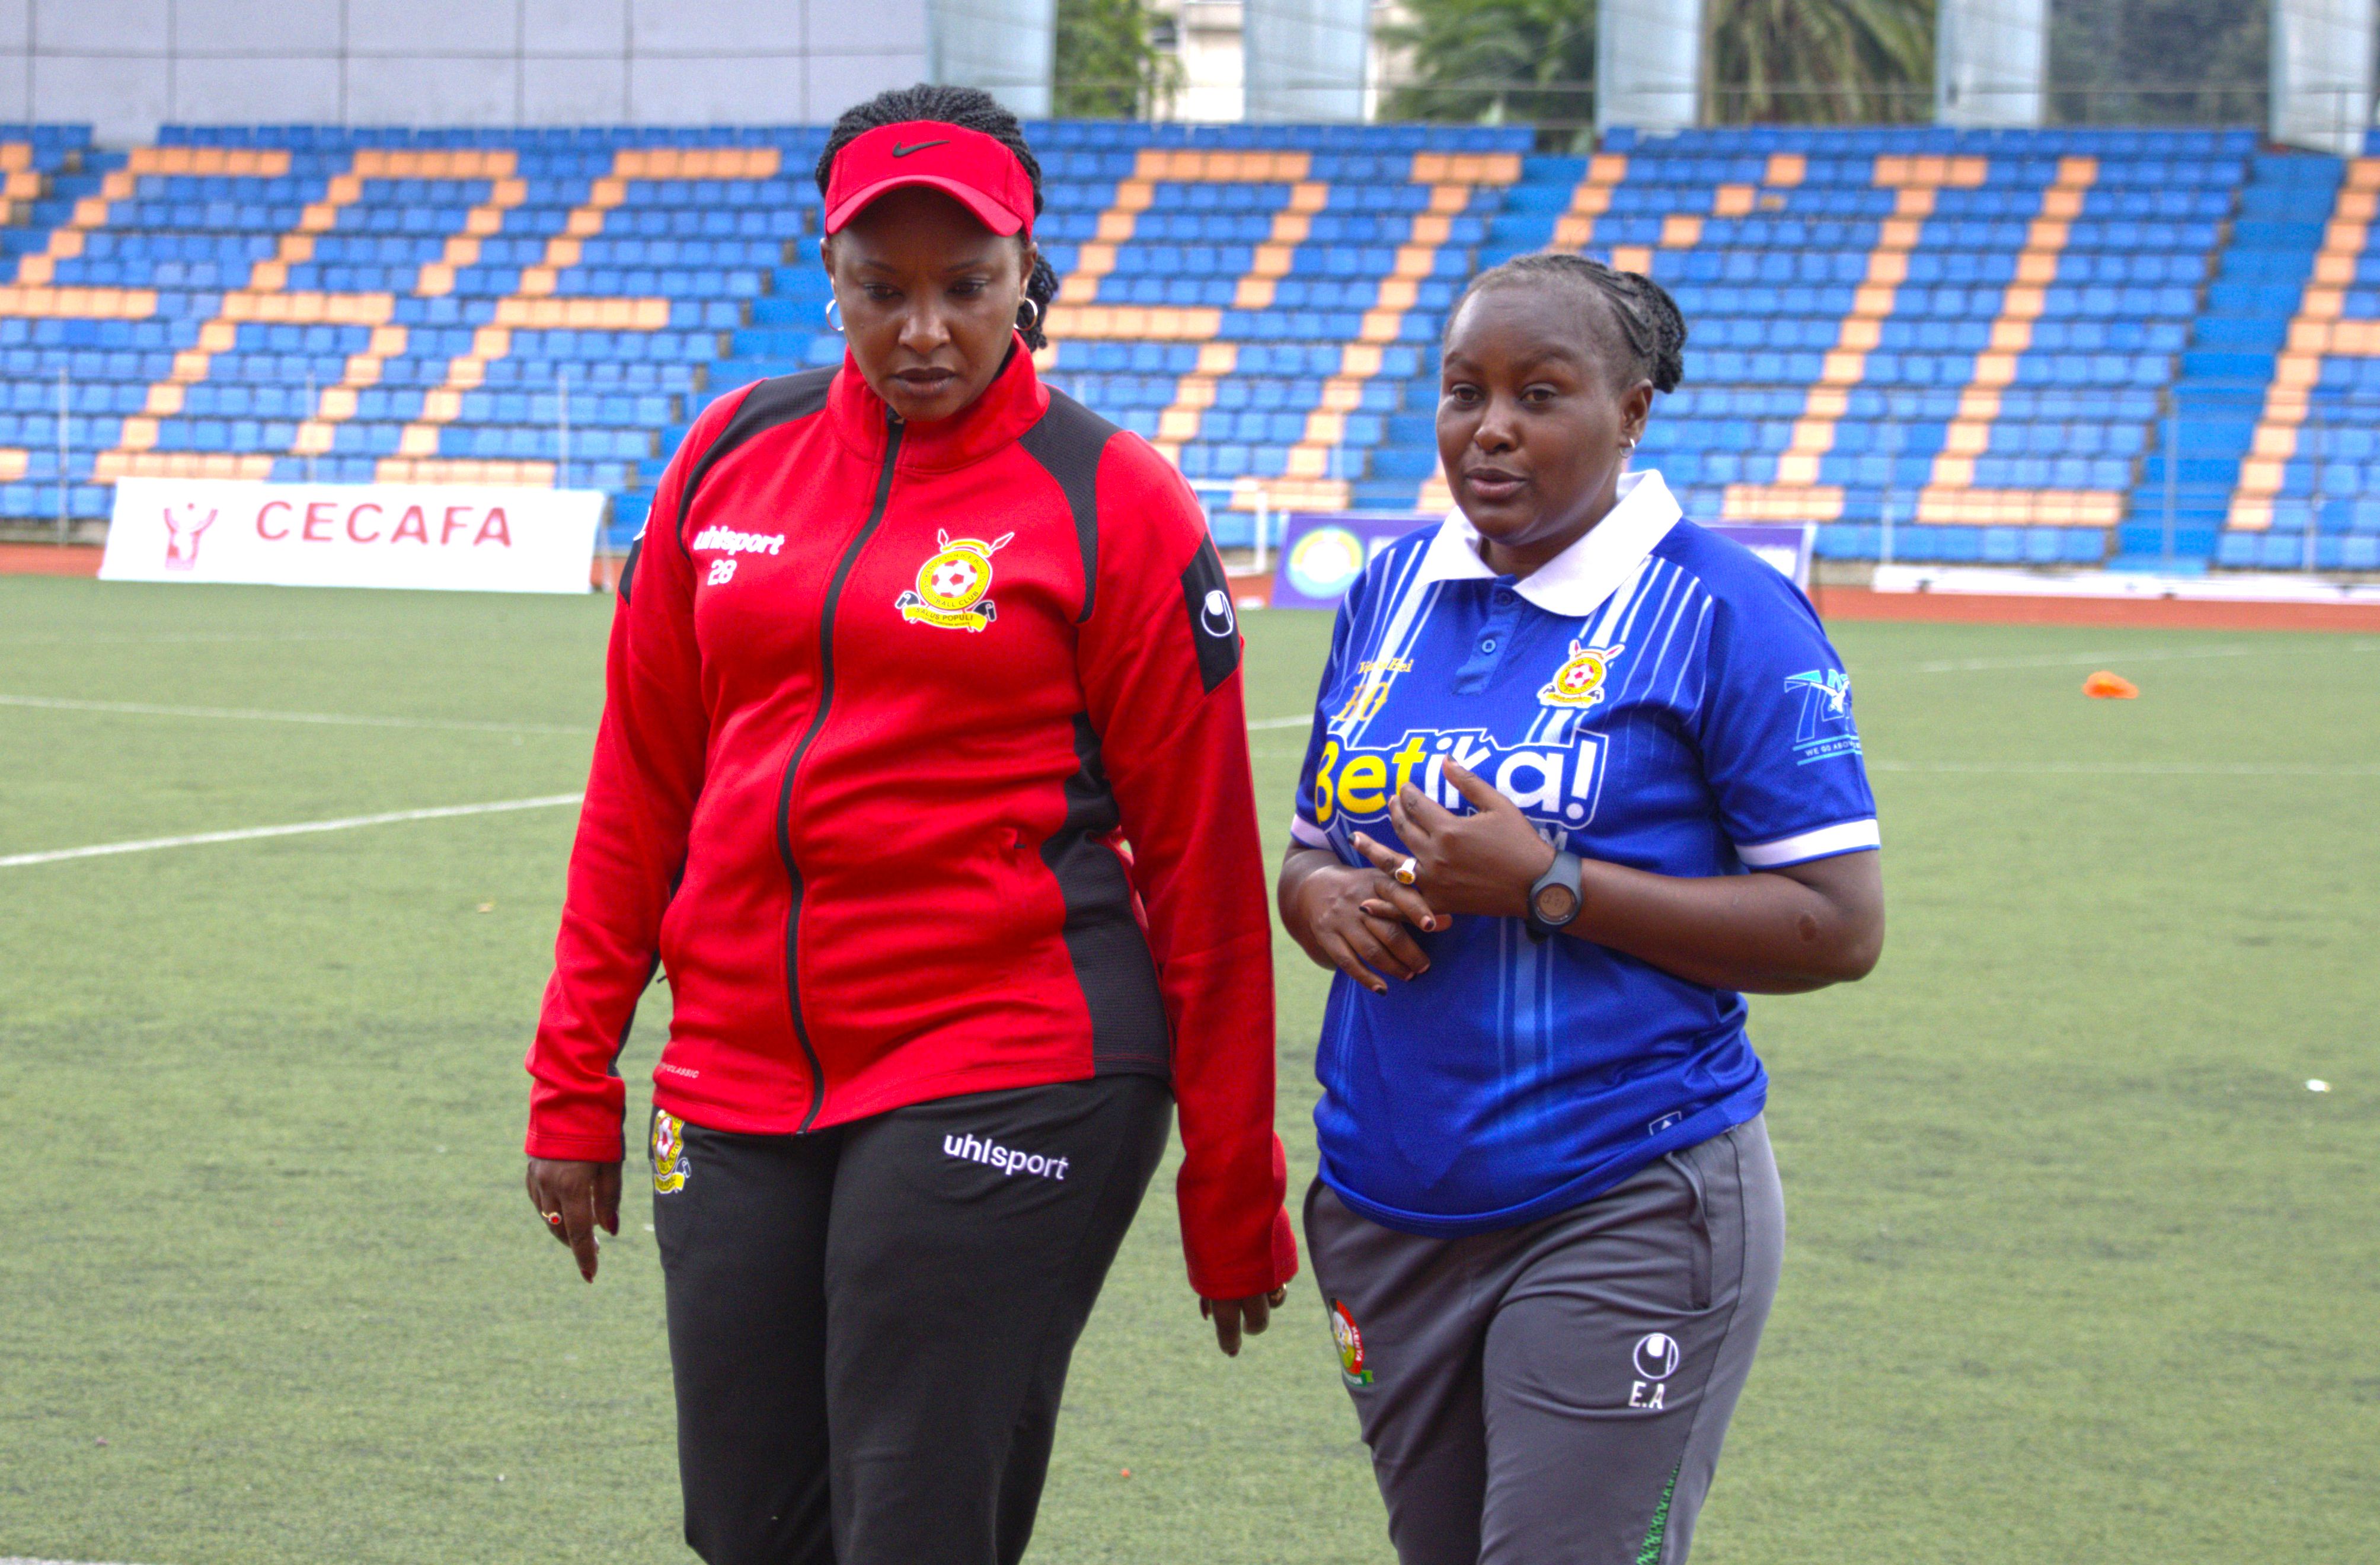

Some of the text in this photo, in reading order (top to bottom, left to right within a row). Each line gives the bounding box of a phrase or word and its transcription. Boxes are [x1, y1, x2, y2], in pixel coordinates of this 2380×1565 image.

[256, 501, 512, 547] CECAFA
[694, 526, 784, 555] uhlsport
[707, 559, 737, 586] 28
[958, 590, 979, 606] CLUB
[915, 607, 940, 620] SALUS
[1805, 747, 1819, 757] WE
[1314, 736, 1598, 825] Betika!
[943, 1133, 1069, 1180] uhlsport
[1351, 1326, 1364, 1362] KENYA
